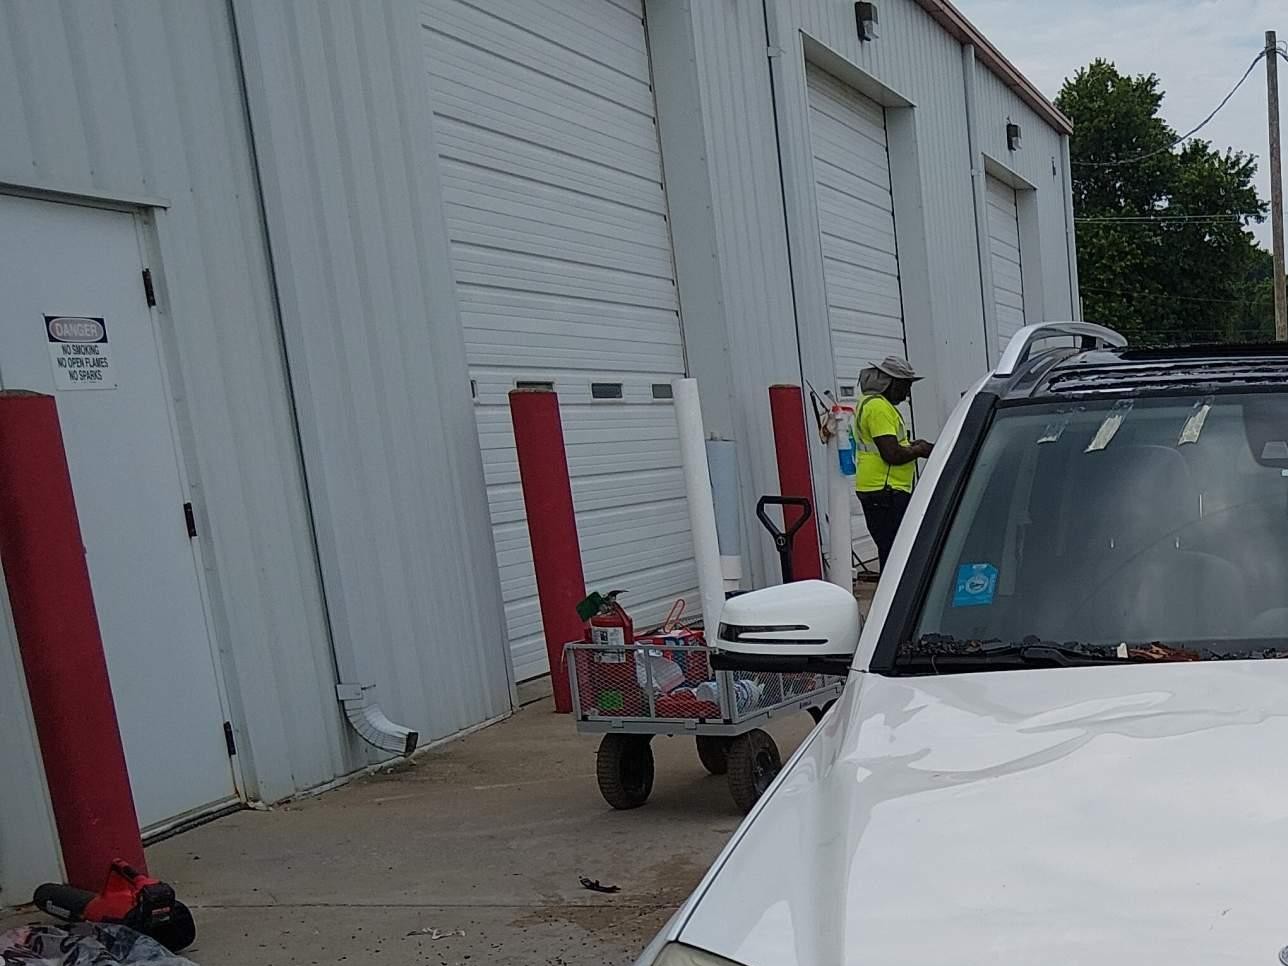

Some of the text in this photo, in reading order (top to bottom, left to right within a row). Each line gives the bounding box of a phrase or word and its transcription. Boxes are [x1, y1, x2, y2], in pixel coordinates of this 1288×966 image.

[55, 323, 98, 337] DANGER
[62, 344, 100, 355] NO SMOKING
[57, 357, 109, 368] NO OPEN FLAMES
[69, 370, 103, 381] NO SPARKS
